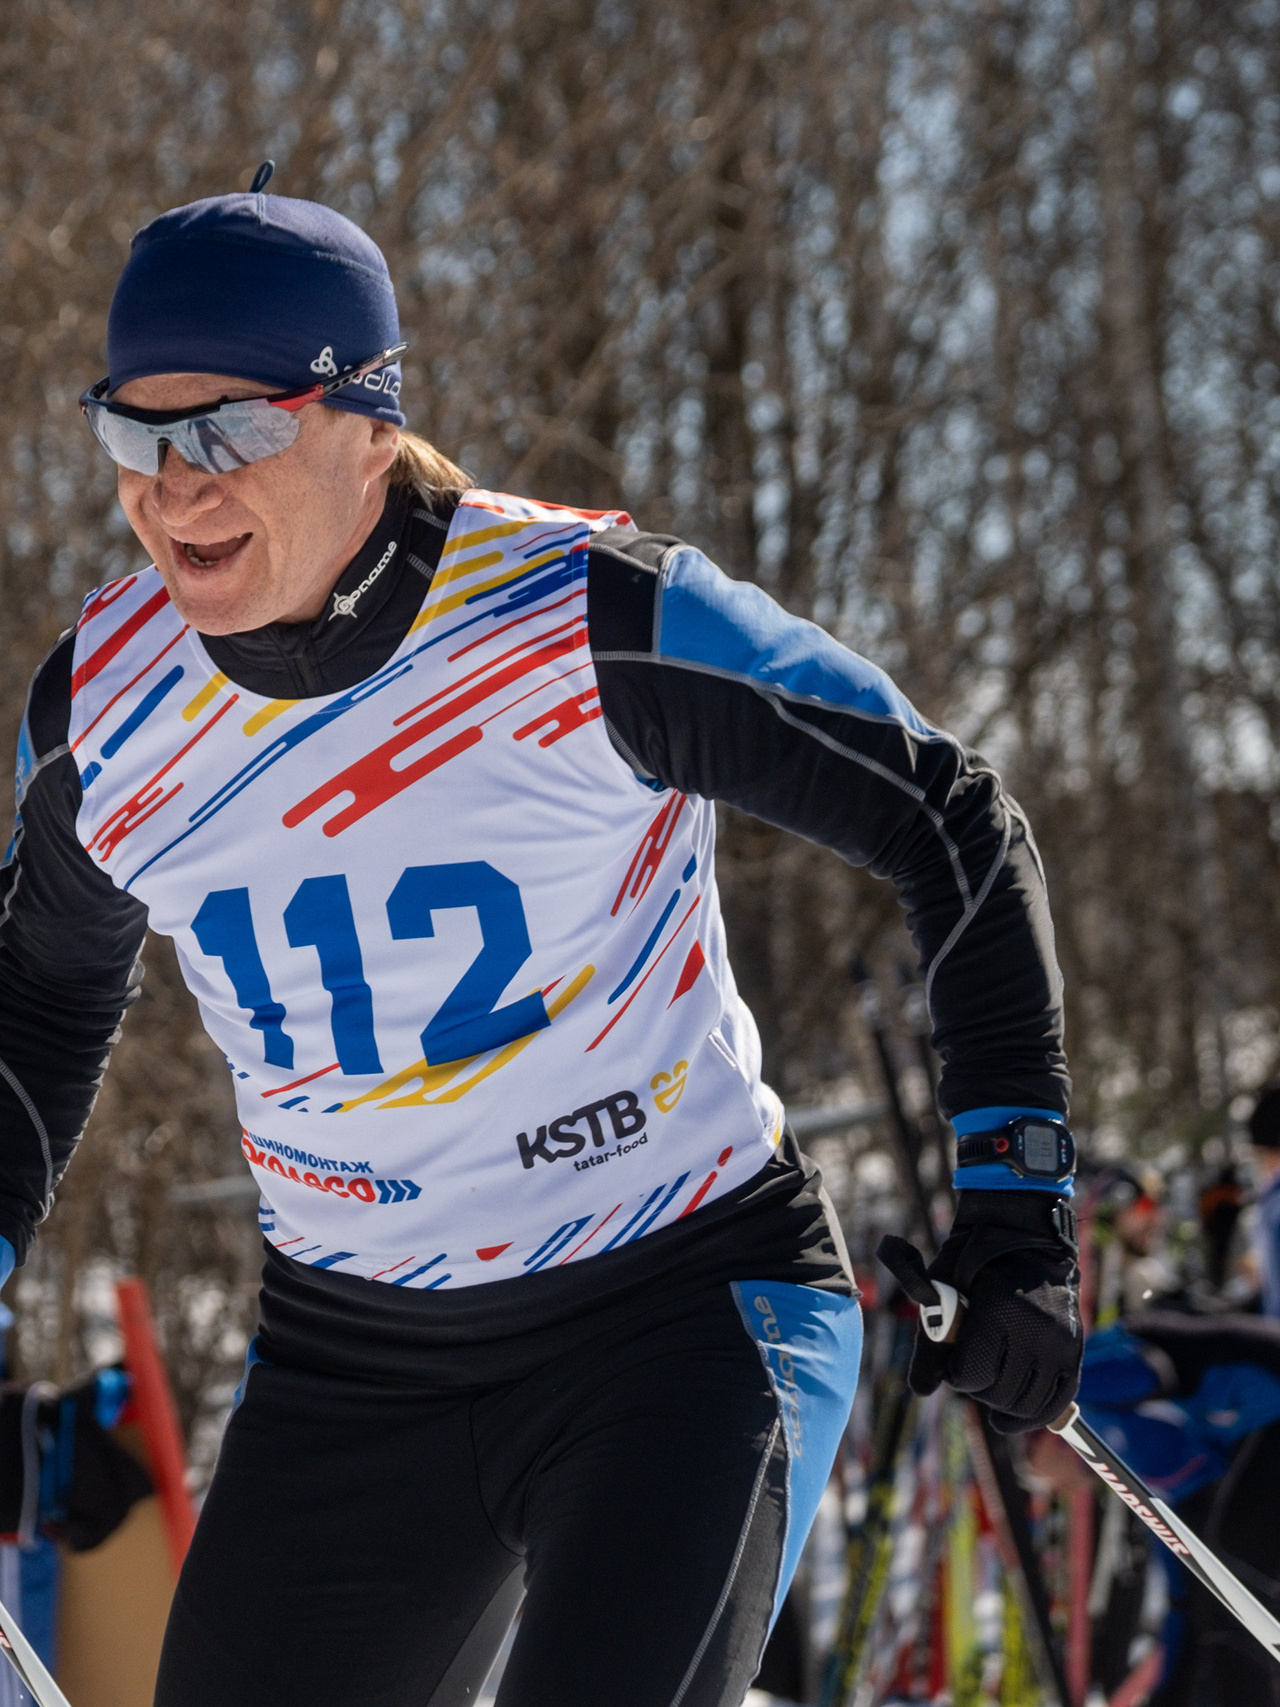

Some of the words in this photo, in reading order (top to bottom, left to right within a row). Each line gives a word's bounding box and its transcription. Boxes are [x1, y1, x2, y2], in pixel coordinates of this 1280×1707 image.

[190, 860, 551, 1076] 112
[249, 1131, 374, 1174] ШИНОМОНТАЖ
[516, 1090, 647, 1170] KSTB
[573, 1132, 648, 1172] tatar-food
[1086, 1459, 1191, 1556] MADSHUS
